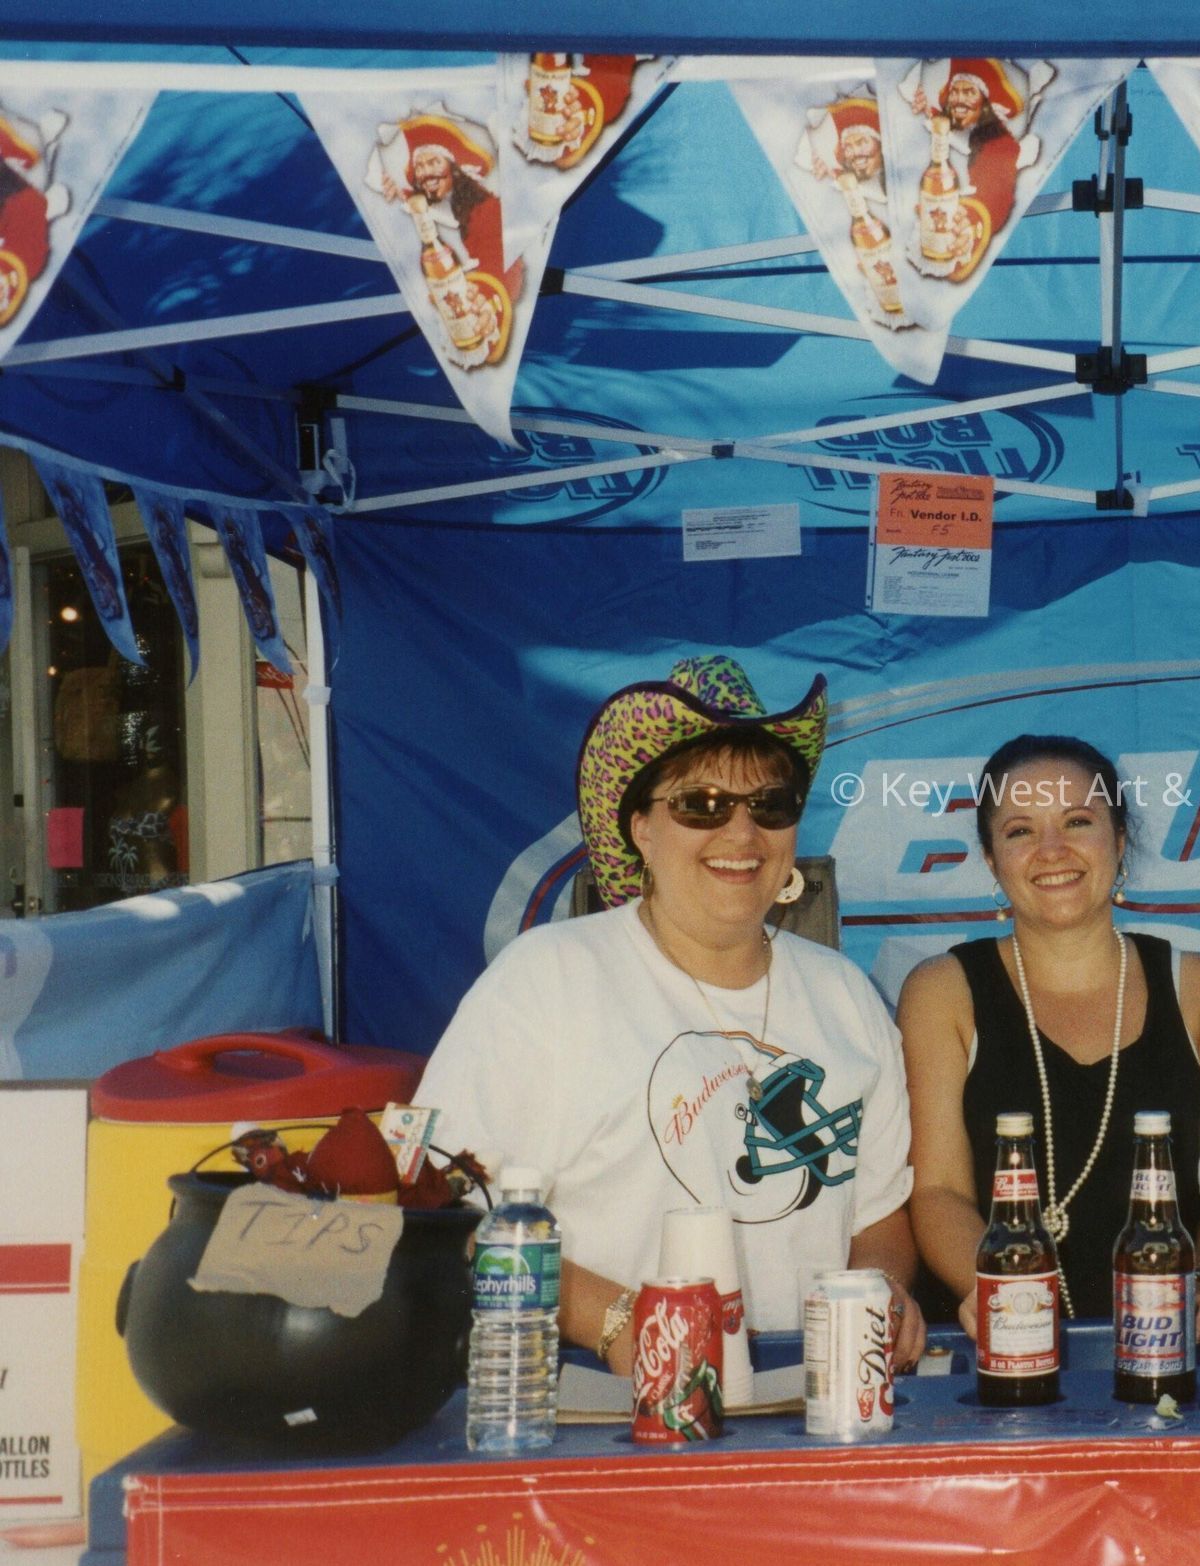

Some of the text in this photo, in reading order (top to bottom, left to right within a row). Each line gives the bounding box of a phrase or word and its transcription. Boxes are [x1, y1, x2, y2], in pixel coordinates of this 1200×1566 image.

[910, 509, 982, 523] Vendor I.D.
[240, 1200, 384, 1254] TIPS
[1122, 1314, 1173, 1330] BUD
[858, 1306, 887, 1385] Diet
